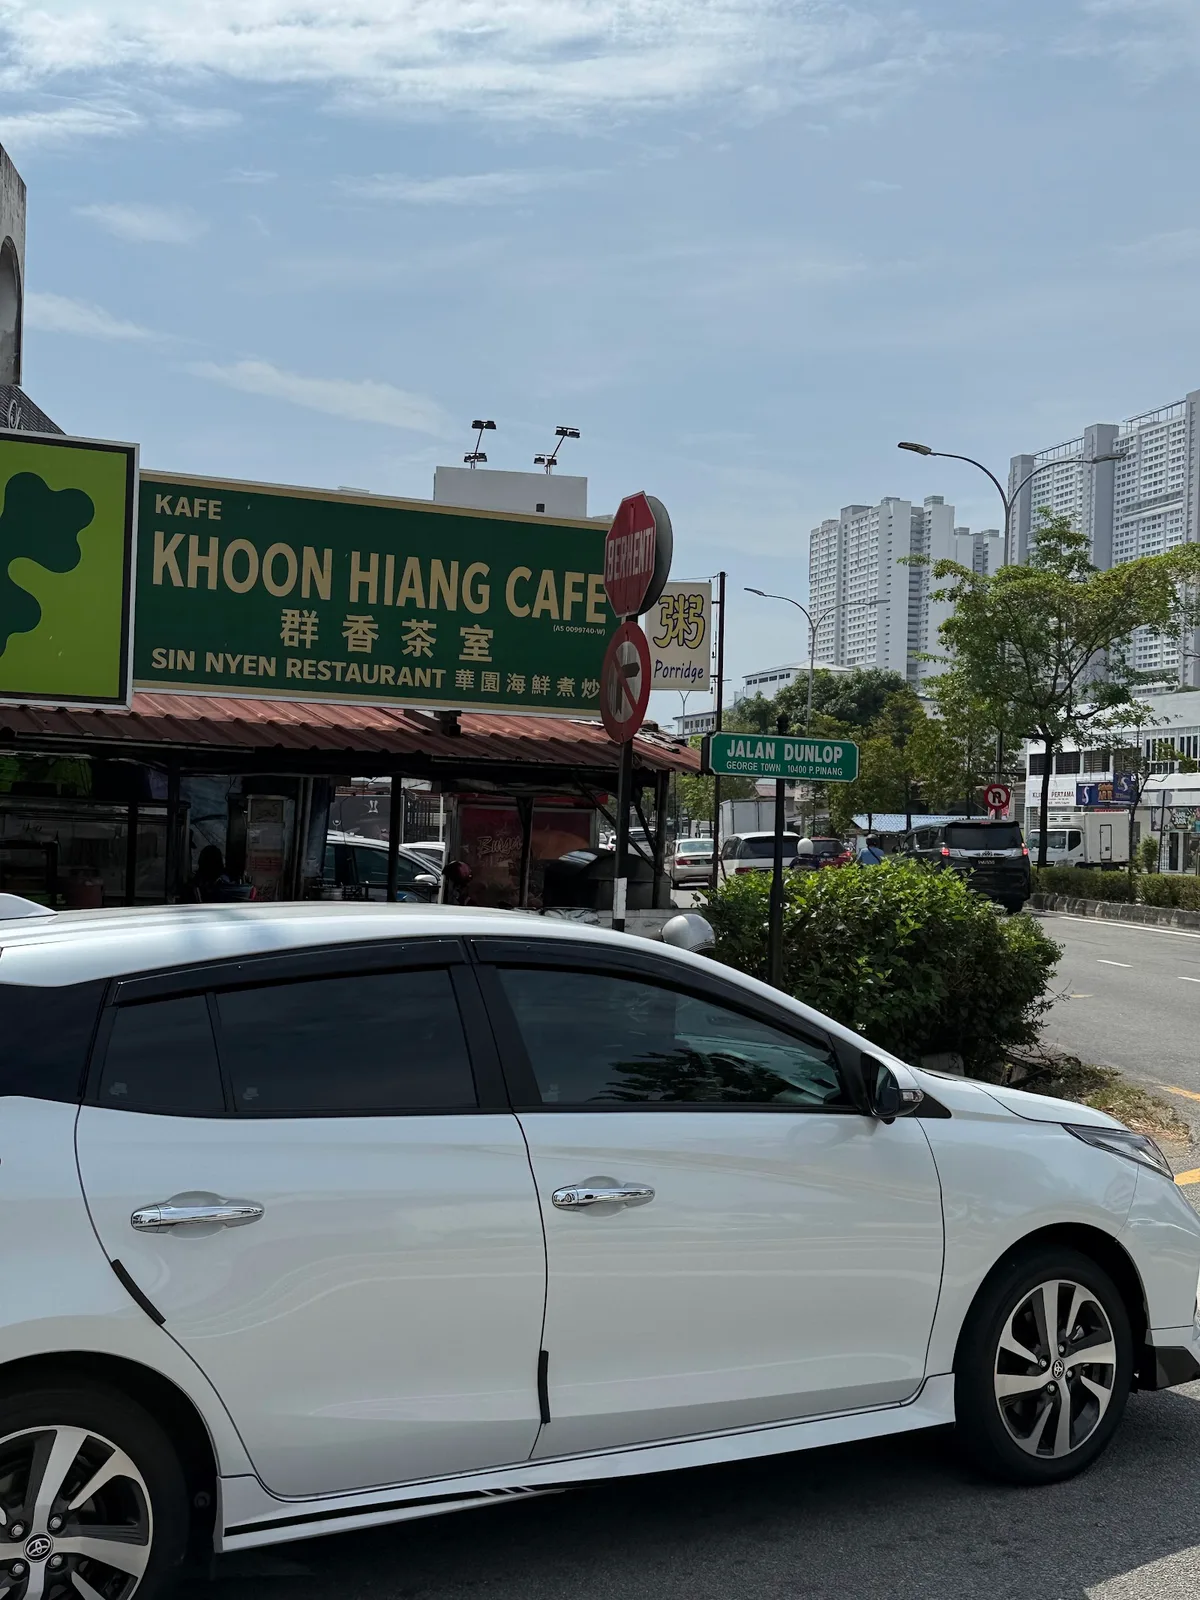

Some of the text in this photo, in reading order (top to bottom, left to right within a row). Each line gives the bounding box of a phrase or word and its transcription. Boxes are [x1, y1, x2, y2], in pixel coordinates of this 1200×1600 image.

[155, 494, 222, 520] KAFE
[606, 527, 653, 582] BERHENTI
[153, 531, 607, 623] KHOON HIANG CAFE
[279, 608, 494, 662] 群香茶室
[652, 593, 706, 649] 粥
[151, 648, 446, 688] SIN NYEN RESTAURANT
[653, 659, 704, 683] Porridge
[726, 760, 758, 772] GEORGE
[761, 763, 781, 773] TOWN
[787, 764, 807, 774] 10400
[727, 739, 843, 764] JALAN DUNLOP
